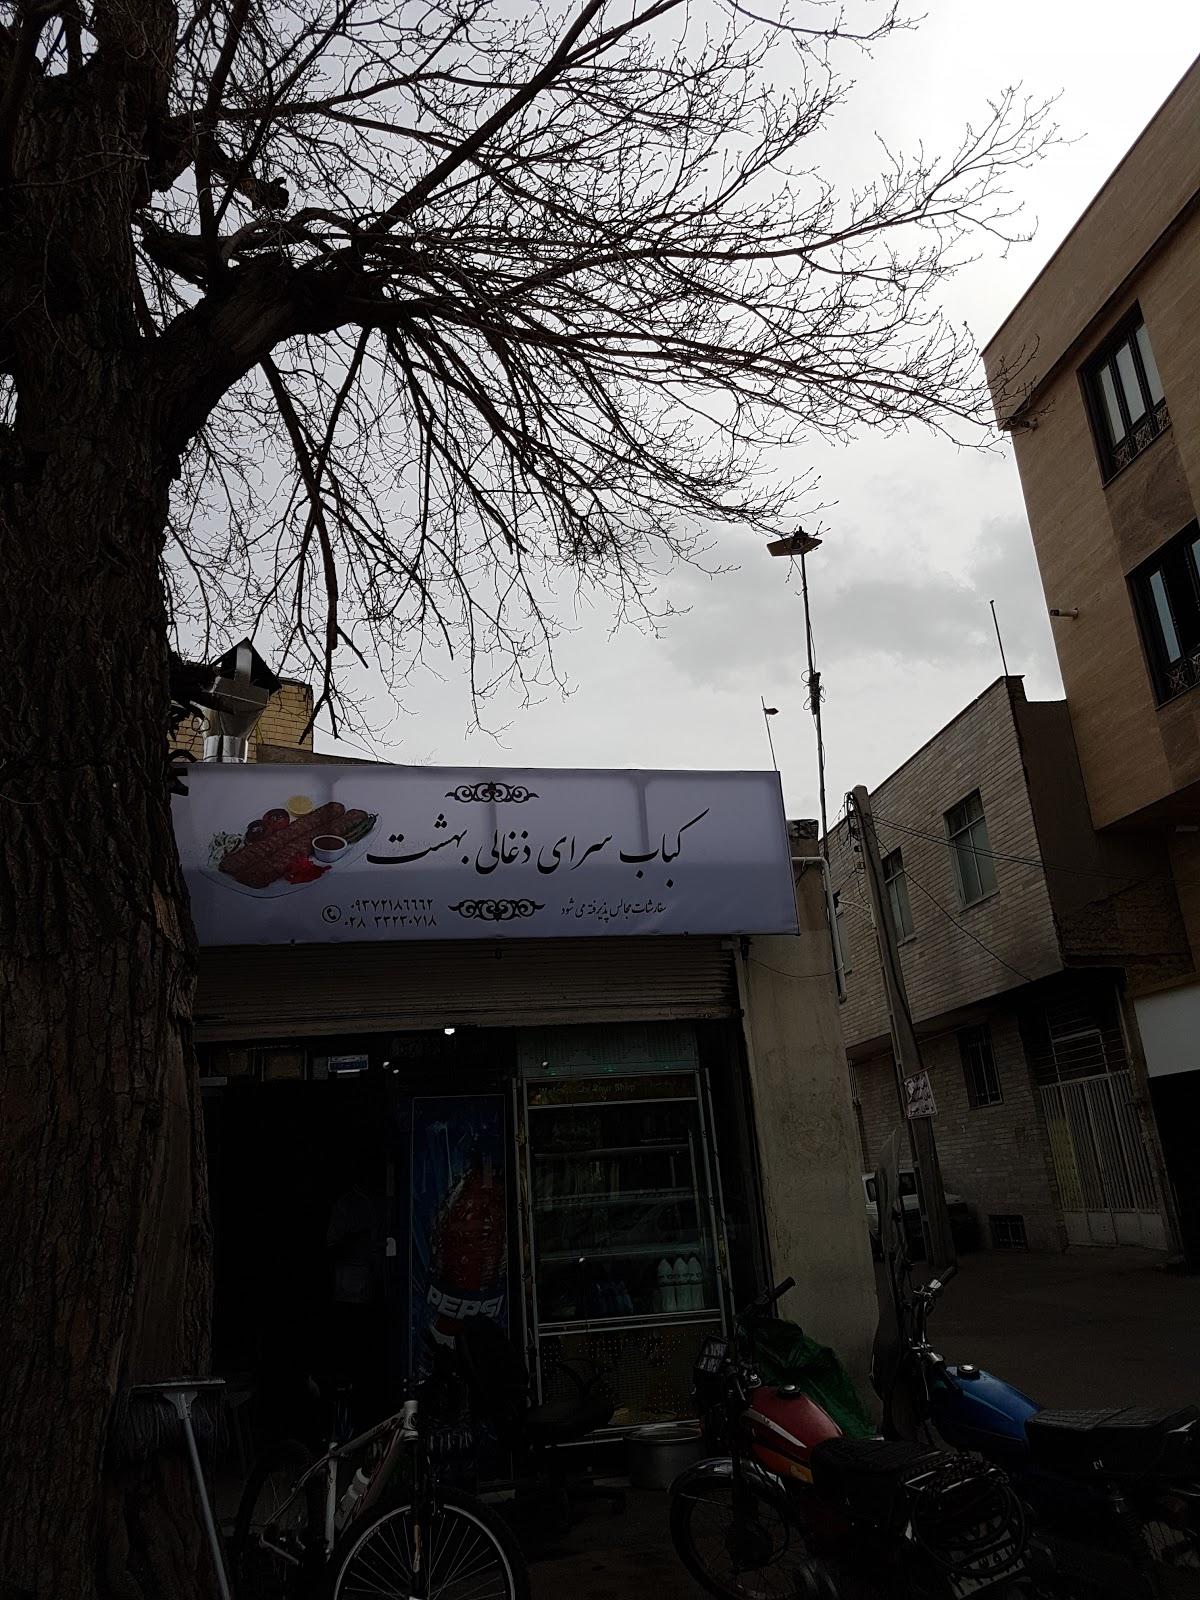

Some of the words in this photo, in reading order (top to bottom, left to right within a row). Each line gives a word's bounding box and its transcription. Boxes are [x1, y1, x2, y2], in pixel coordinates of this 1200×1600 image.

[366, 813, 469, 865] بهشت
[475, 829, 532, 875] ذغالی
[619, 808, 710, 888] کباب
[537, 834, 613, 875] سرای
[561, 897, 575, 915] شود
[575, 903, 586, 918] می
[587, 900, 609, 923] پذیرفته
[610, 899, 632, 919] مجالس
[632, 899, 667, 914] سفارشات
[427, 1284, 505, 1320] PEPSI
